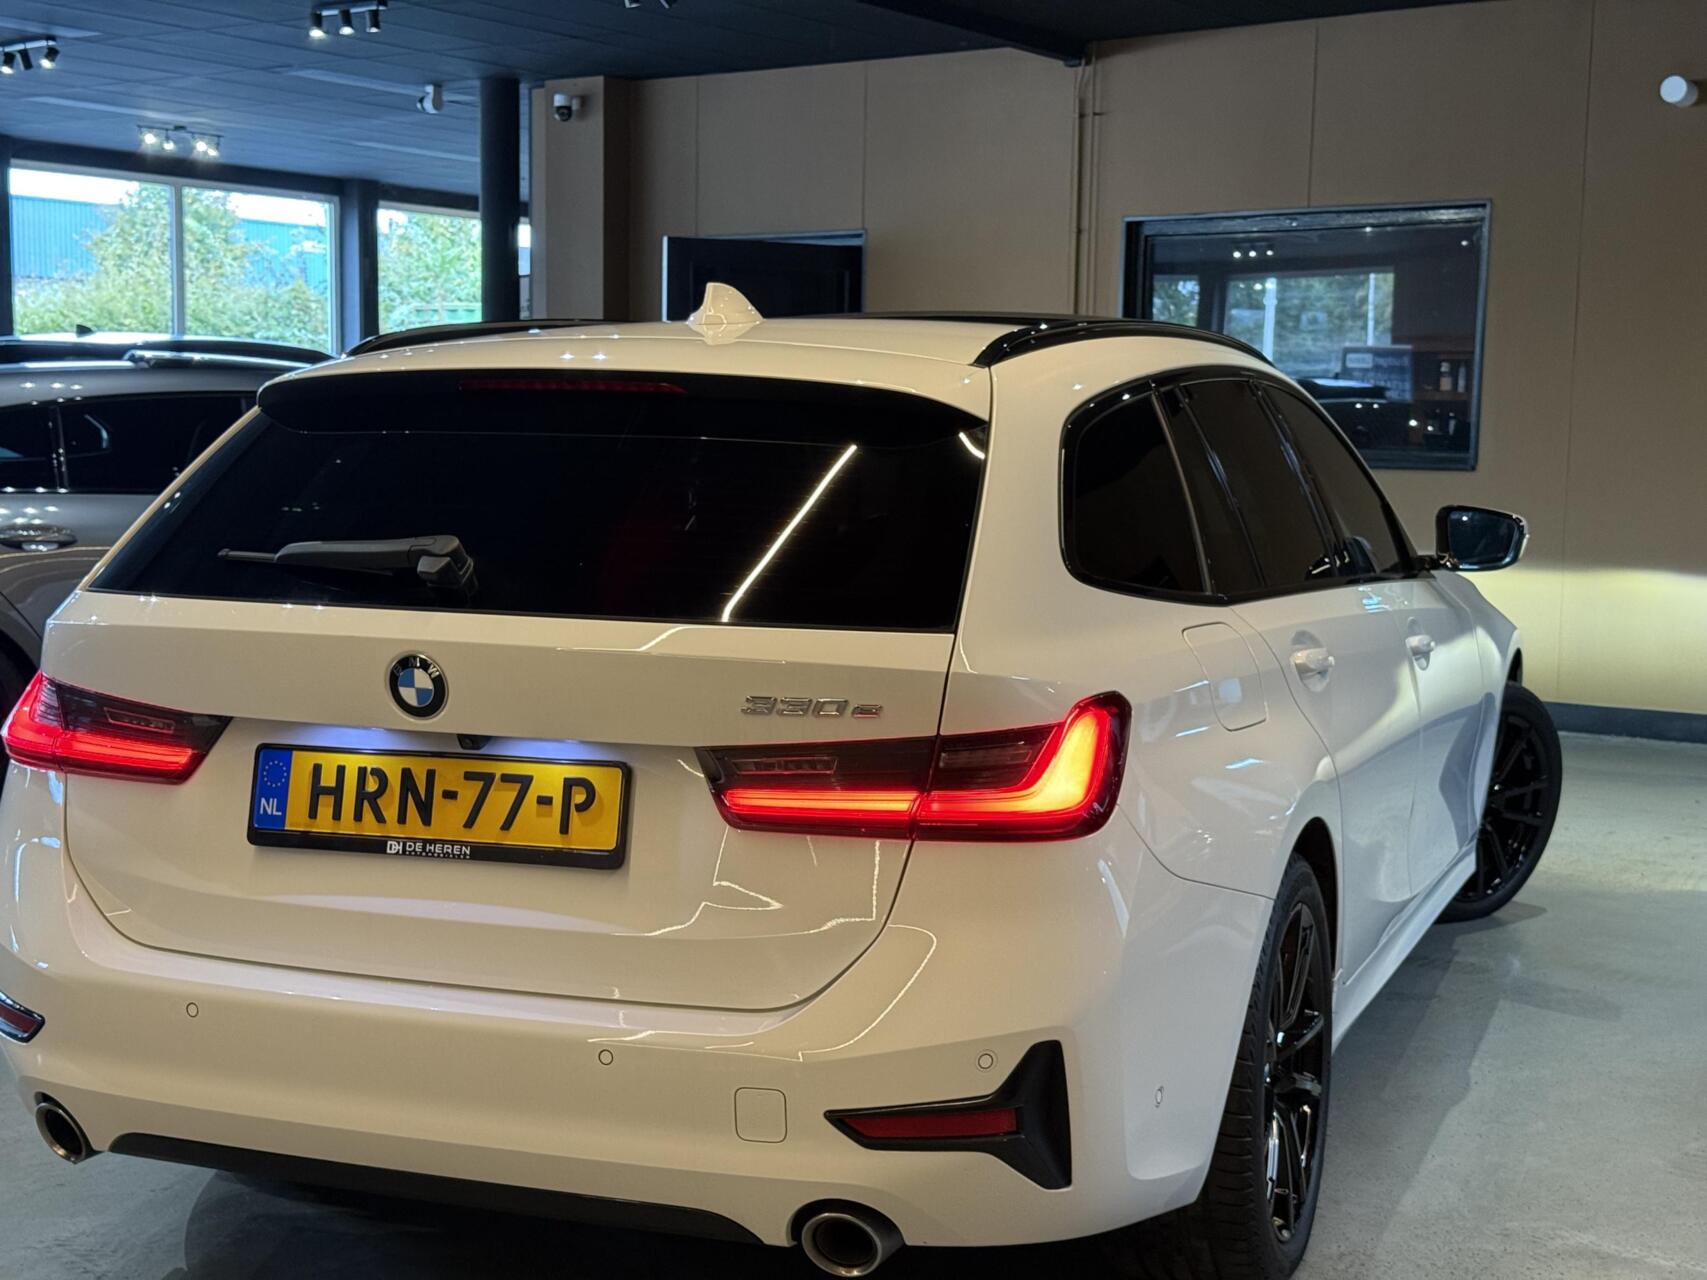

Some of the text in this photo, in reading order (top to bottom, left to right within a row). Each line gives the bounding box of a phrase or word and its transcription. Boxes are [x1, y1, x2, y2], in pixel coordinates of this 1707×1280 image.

[393, 657, 440, 679] BMW
[741, 696, 883, 719] 330e
[259, 797, 283, 816] NL
[308, 763, 597, 835] HRN-77-P
[406, 842, 423, 851] DE
[426, 843, 471, 855] HEREN
